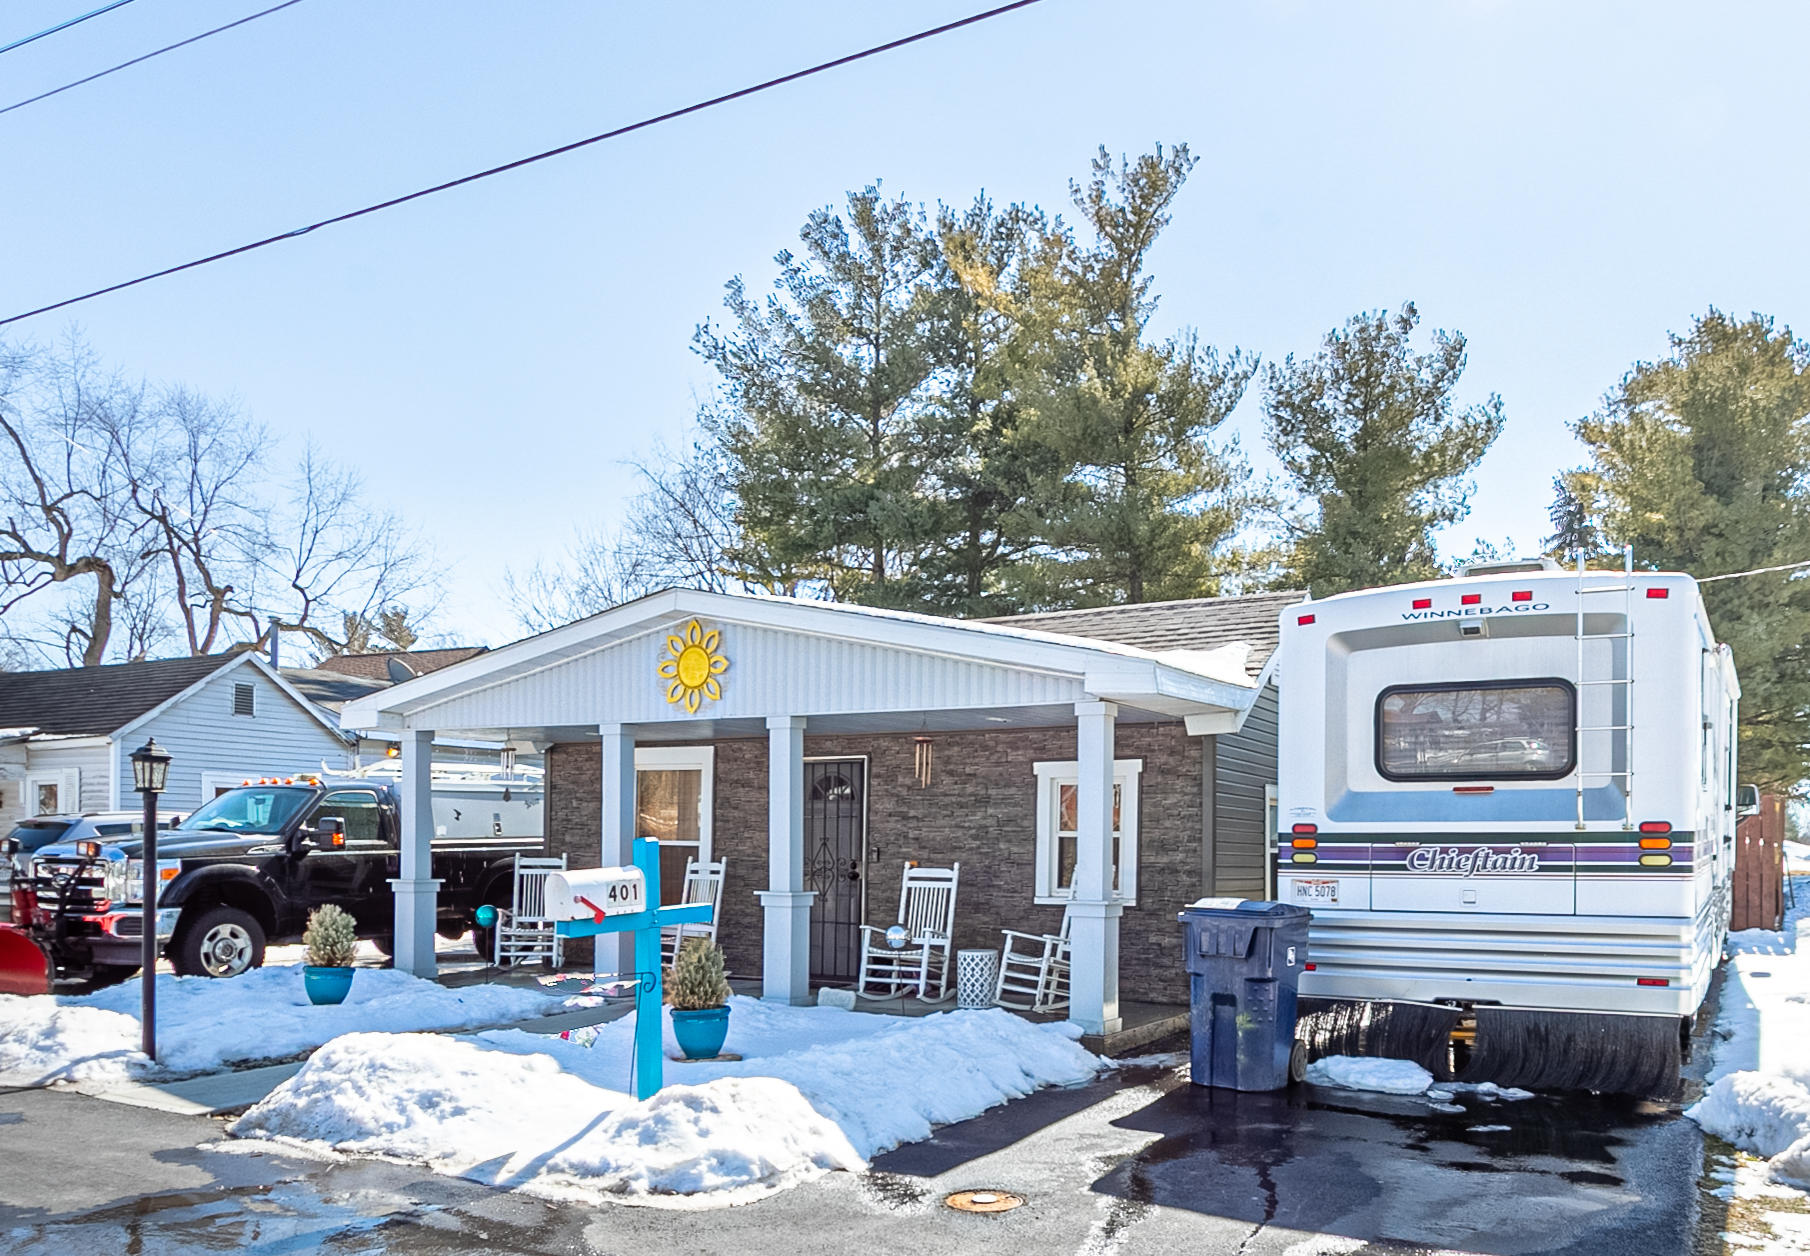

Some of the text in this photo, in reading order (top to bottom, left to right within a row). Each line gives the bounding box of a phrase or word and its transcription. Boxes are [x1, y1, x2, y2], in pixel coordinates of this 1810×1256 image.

[1402, 603, 1550, 620] WINNEBAGO
[1406, 847, 1539, 878] Chieftain
[608, 883, 638, 902] 401
[1315, 885, 1337, 897] 5078
